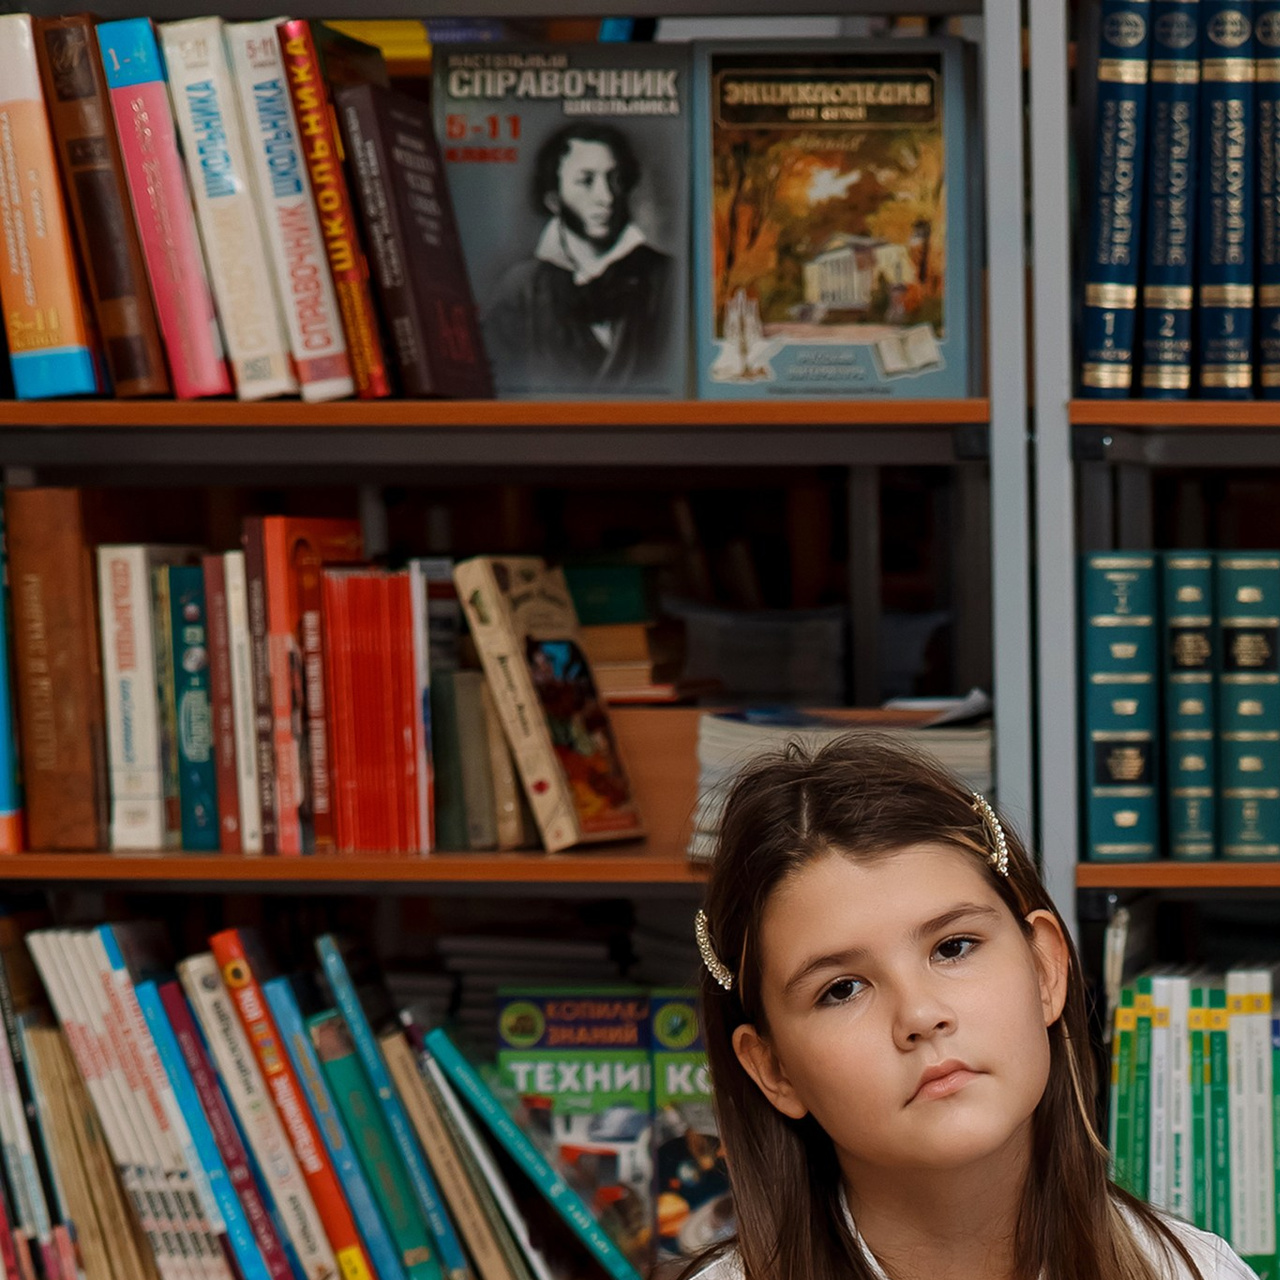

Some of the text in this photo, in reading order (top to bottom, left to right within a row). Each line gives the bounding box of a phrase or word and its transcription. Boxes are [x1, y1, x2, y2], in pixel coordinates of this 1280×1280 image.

[449, 69, 679, 98] СПРАВОЧНИК
[723, 81, 932, 105] ЭНЦИКЛОПЕДИЯ
[185, 79, 236, 198] ШКОЛЬНИКА
[287, 35, 354, 273] ШКОЛЬНИКА
[446, 114, 522, 140] 5-11
[253, 79, 333, 353] СПРАВОЧНИК ШКОЛЬНИКА
[1110, 100, 1137, 265] ЭНЦИКЛОПЕДИЯ
[1225, 99, 1245, 265] ЭНЦИКЛОПЕДИЯ
[1102, 312, 1115, 335] 1
[1160, 313, 1175, 337] 2
